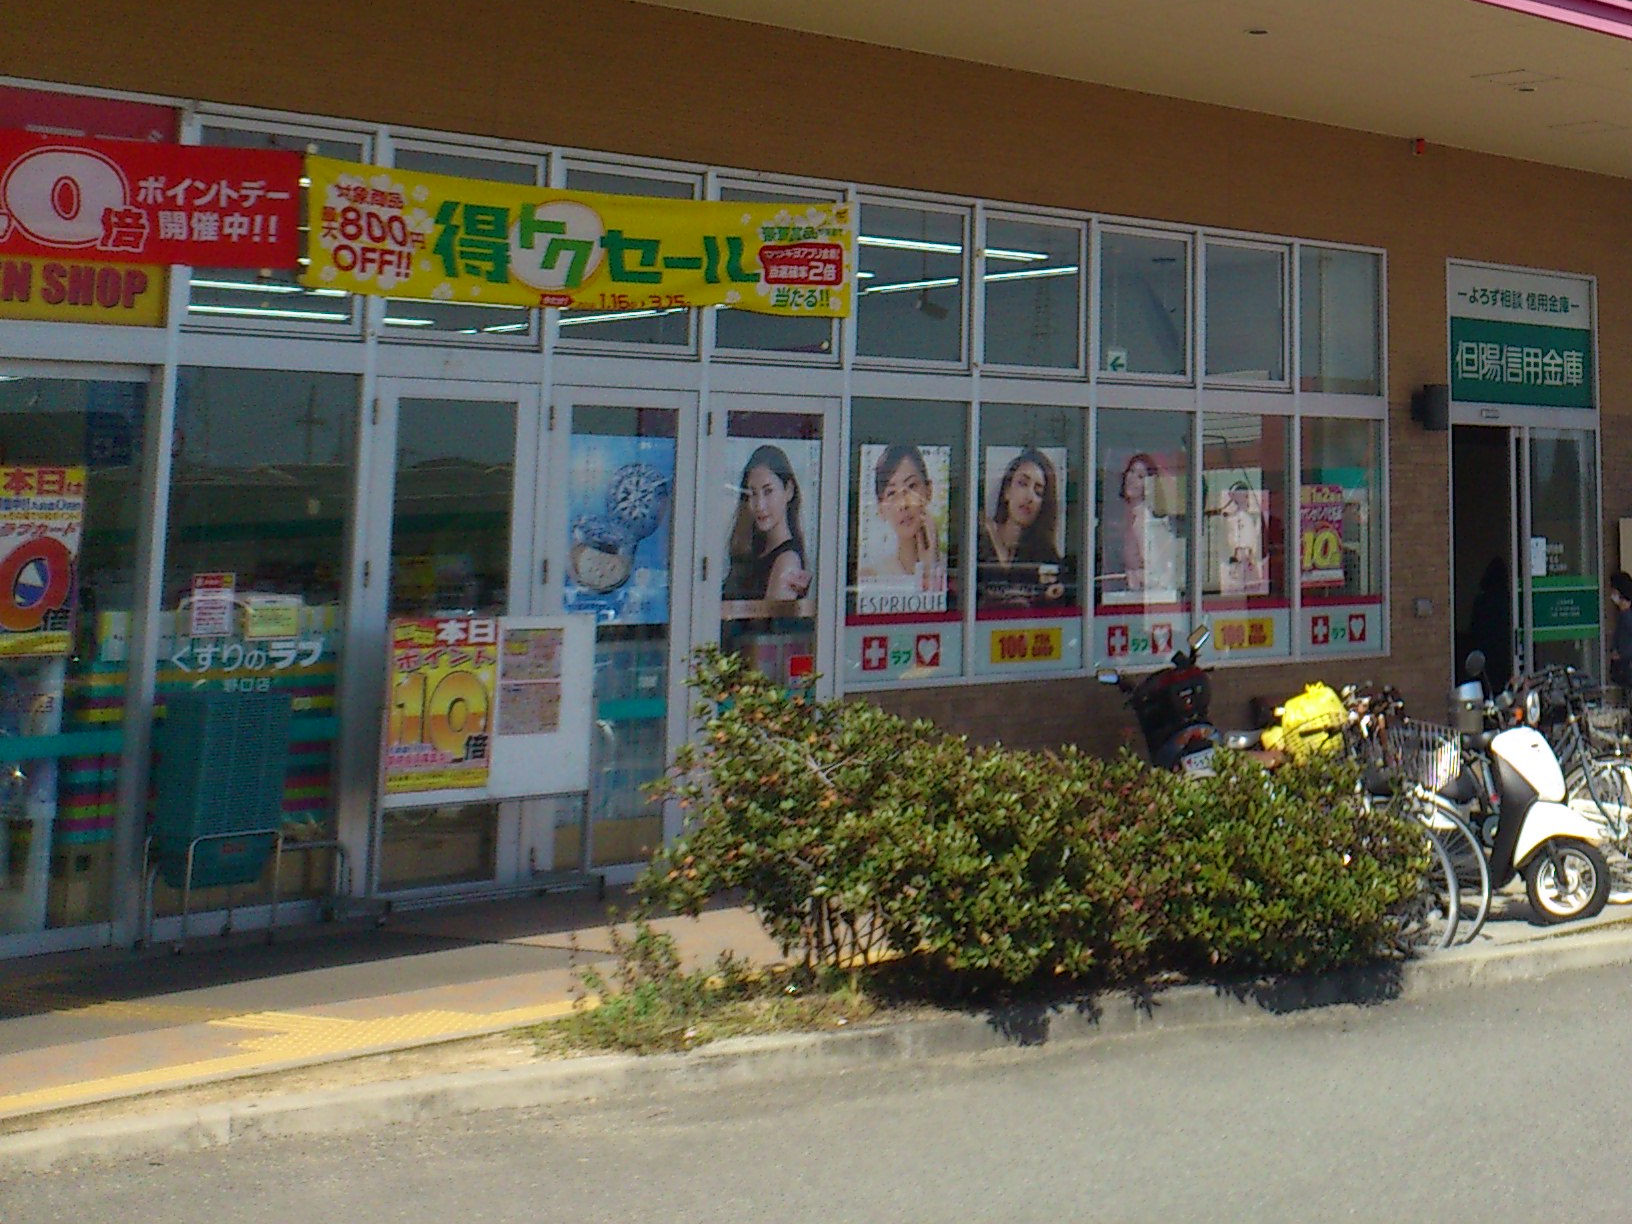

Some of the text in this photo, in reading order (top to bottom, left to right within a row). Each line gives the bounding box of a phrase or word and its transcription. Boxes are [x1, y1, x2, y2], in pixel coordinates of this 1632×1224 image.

[137, 176, 290, 208] ポイントデー
[333, 244, 413, 279] OFF!!
[40, 262, 148, 308] SHOP
[1456, 340, 1584, 387] 但陽信用金庫
[859, 595, 943, 614] ESPRIQUE
[437, 620, 497, 645] 本日
[396, 647, 496, 674] ポイント
